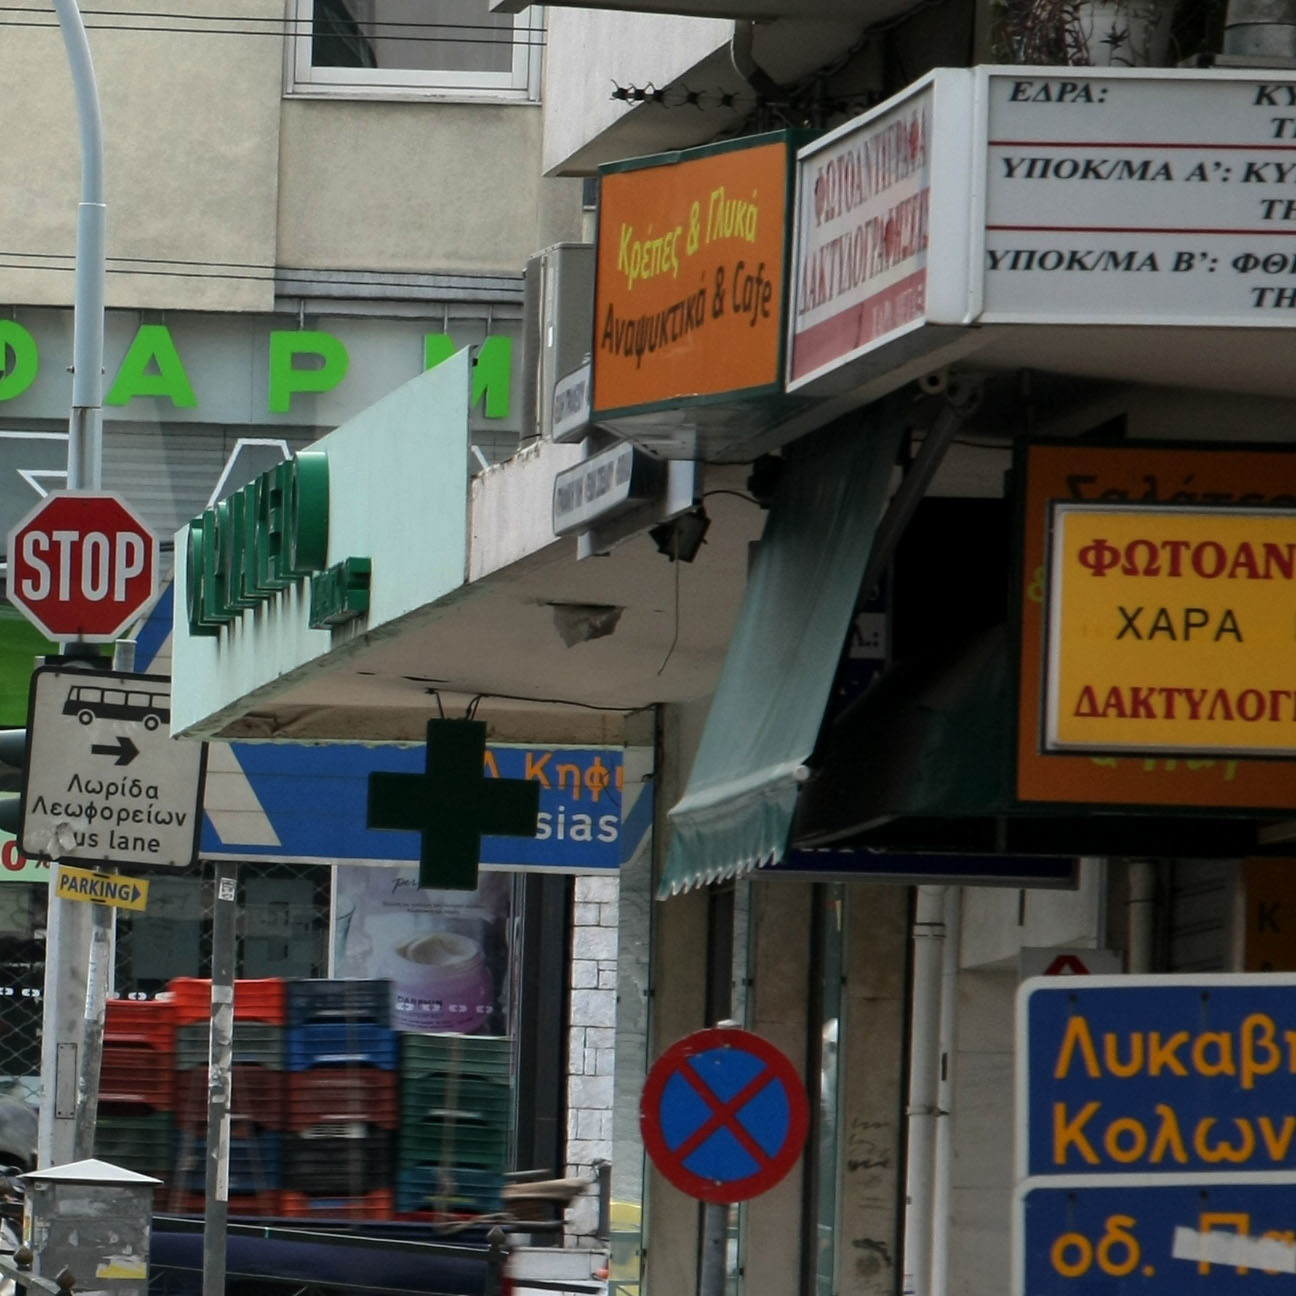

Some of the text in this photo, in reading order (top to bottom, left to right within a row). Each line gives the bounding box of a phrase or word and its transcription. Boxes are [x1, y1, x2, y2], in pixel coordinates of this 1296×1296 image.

[1009, 81, 1108, 103] ΕΔΡΑ:
[1002, 157, 1174, 181] ΥΠΟΚ/ΜΑ
[618, 186, 758, 290] Κρέπες & Γλυκά
[985, 249, 1160, 272] ΥΠΟΚ/ΜΑ
[1231, 252, 1296, 274] ΦΘ
[601, 260, 773, 370] Αναψυκτικά & Cafe
[21, 530, 146, 602] STOP
[1115, 606, 1244, 643] ΧΑΡΑ
[1073, 684, 1296, 722] ΔΑΚΤΥΛΟΓ
[67, 774, 159, 800] Λωρίδα
[31, 795, 188, 828] Λεωφορείων
[109, 830, 161, 852] lane
[60, 874, 131, 901] PARKING
[1051, 1214, 1156, 1278] οδ.
